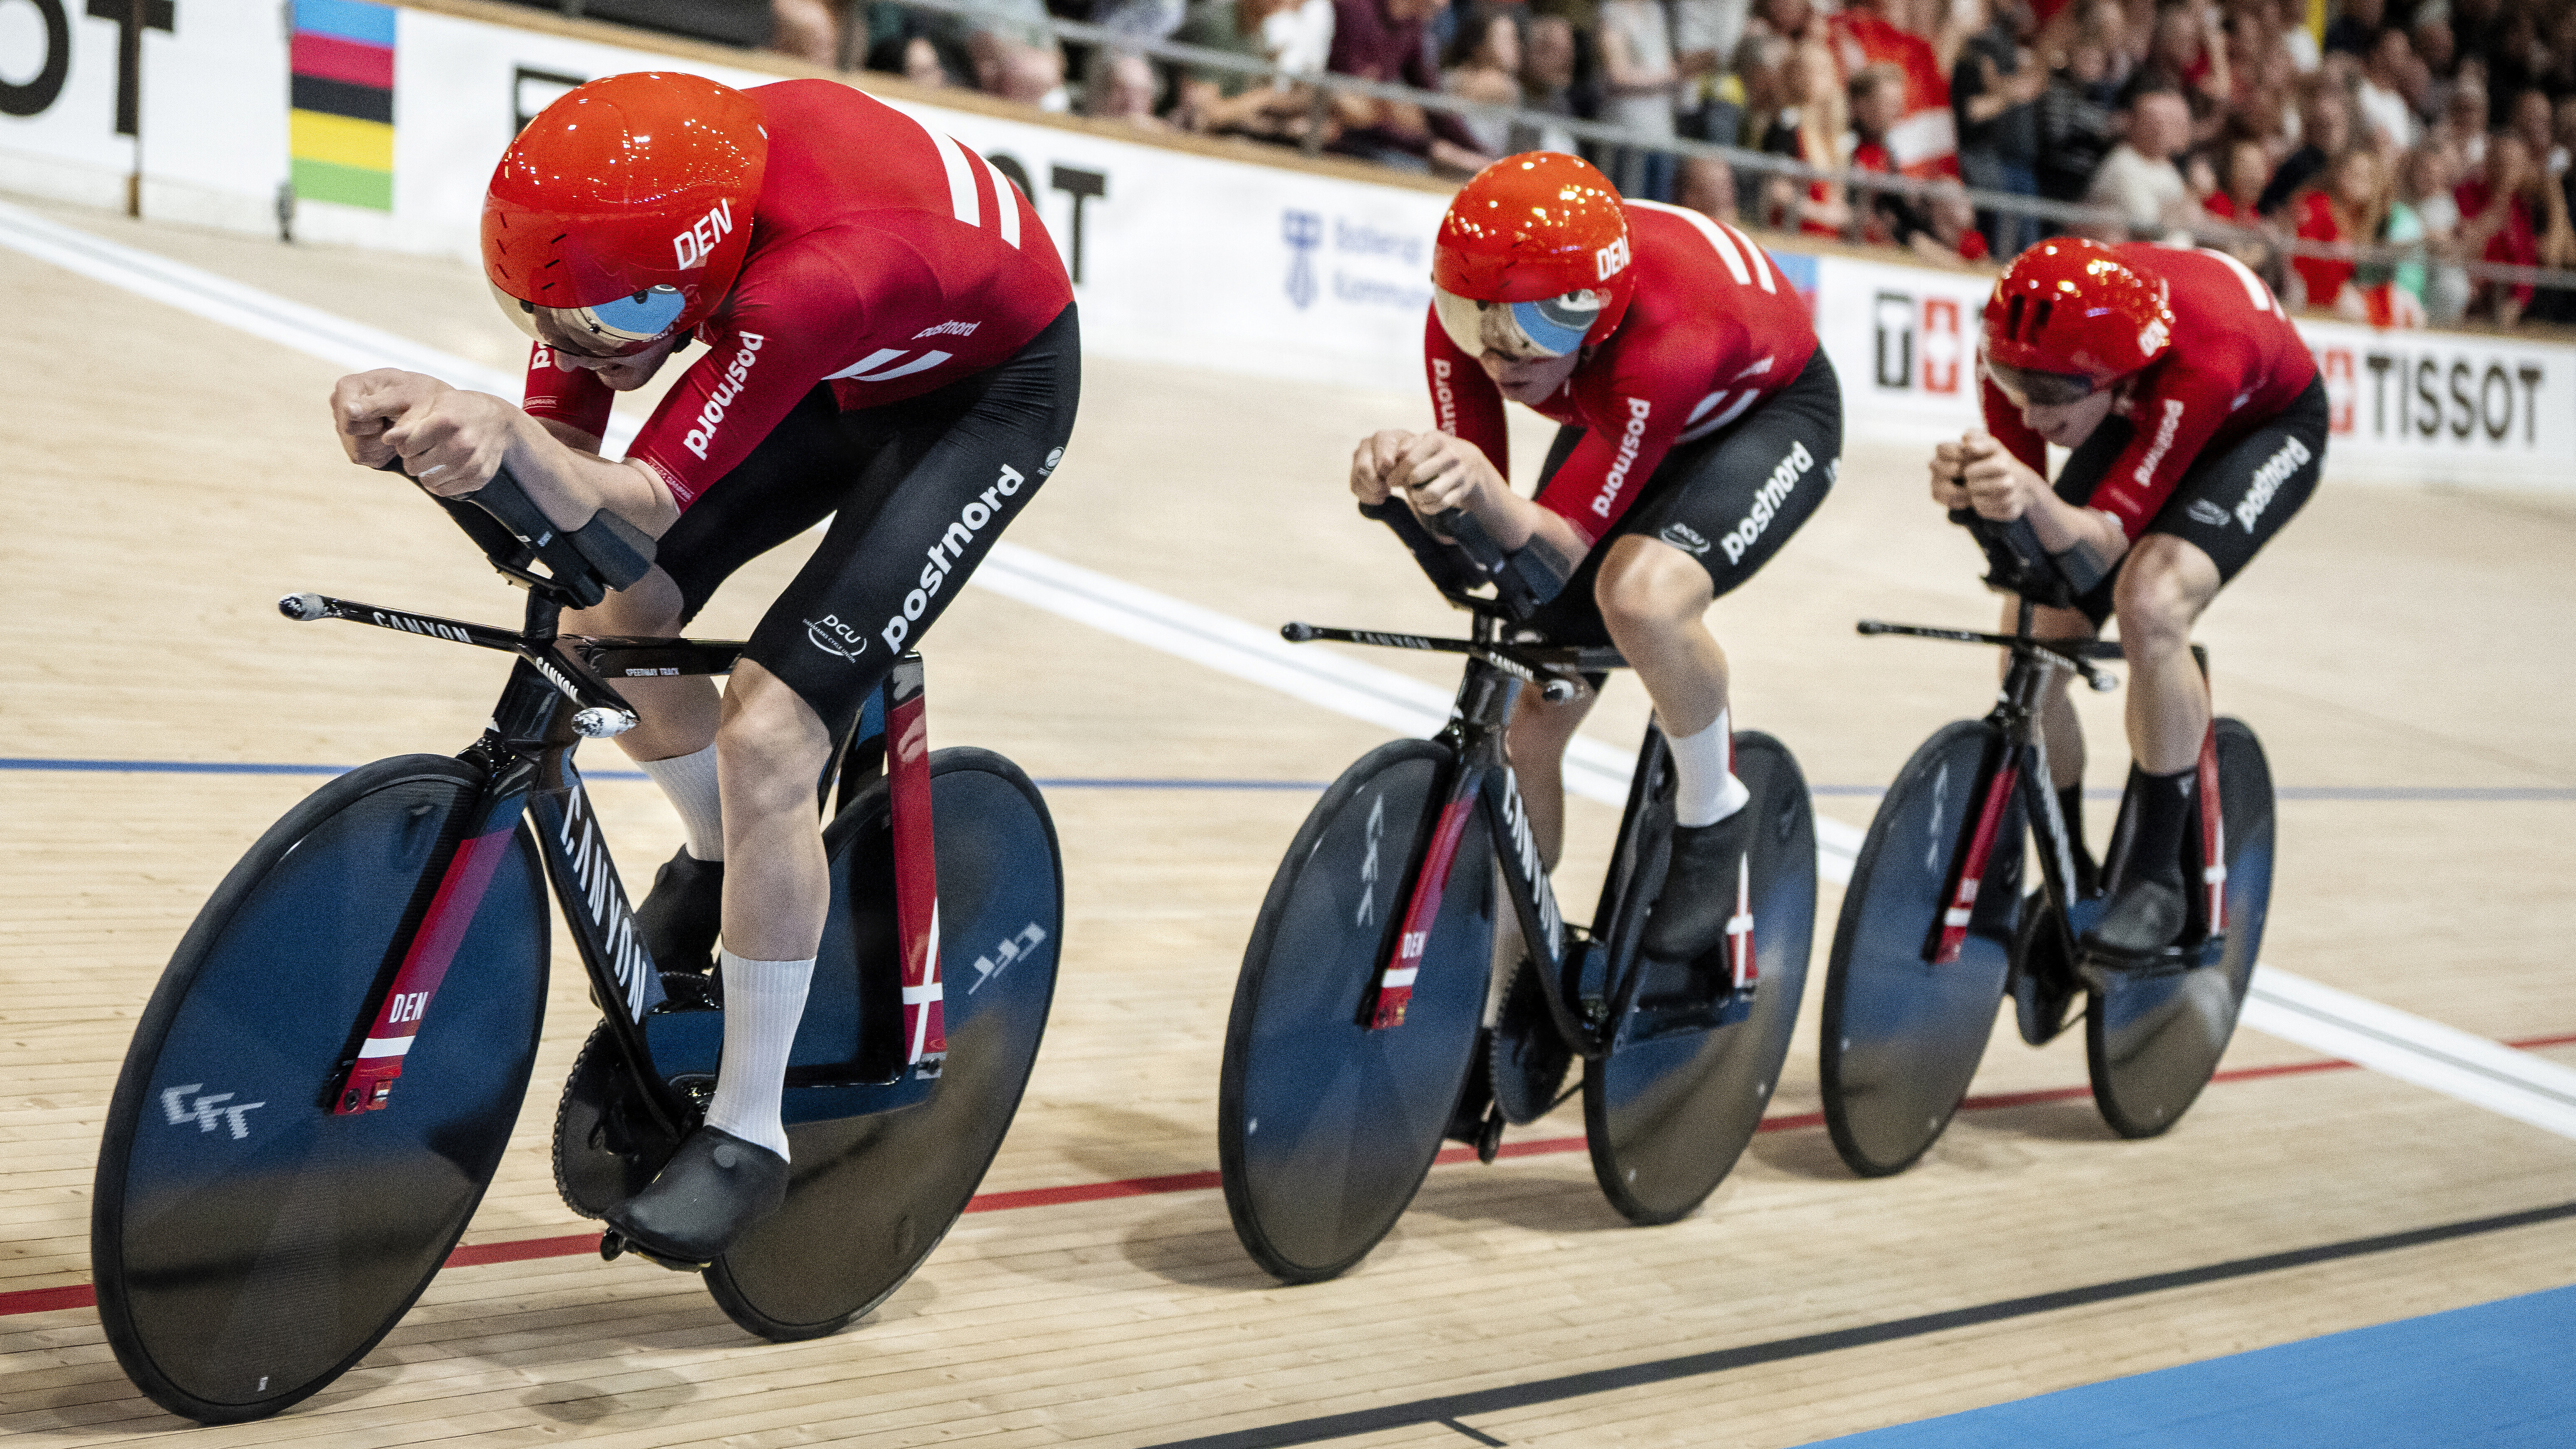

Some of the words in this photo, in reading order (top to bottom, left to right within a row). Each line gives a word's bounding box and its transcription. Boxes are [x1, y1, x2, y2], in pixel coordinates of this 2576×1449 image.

[673, 198, 733, 271] DEN
[1596, 236, 1631, 282] DEN
[683, 331, 764, 461] postnord
[2367, 354, 2542, 443] TISSOT
[1592, 397, 1651, 518] postnord
[1721, 440, 1814, 566] postnord
[881, 463, 1025, 655] postnord
[373, 611, 473, 644] CANYON
[822, 614, 861, 643] DCU
[561, 785, 646, 1025] CANYON
[388, 991, 428, 1023] DEN
